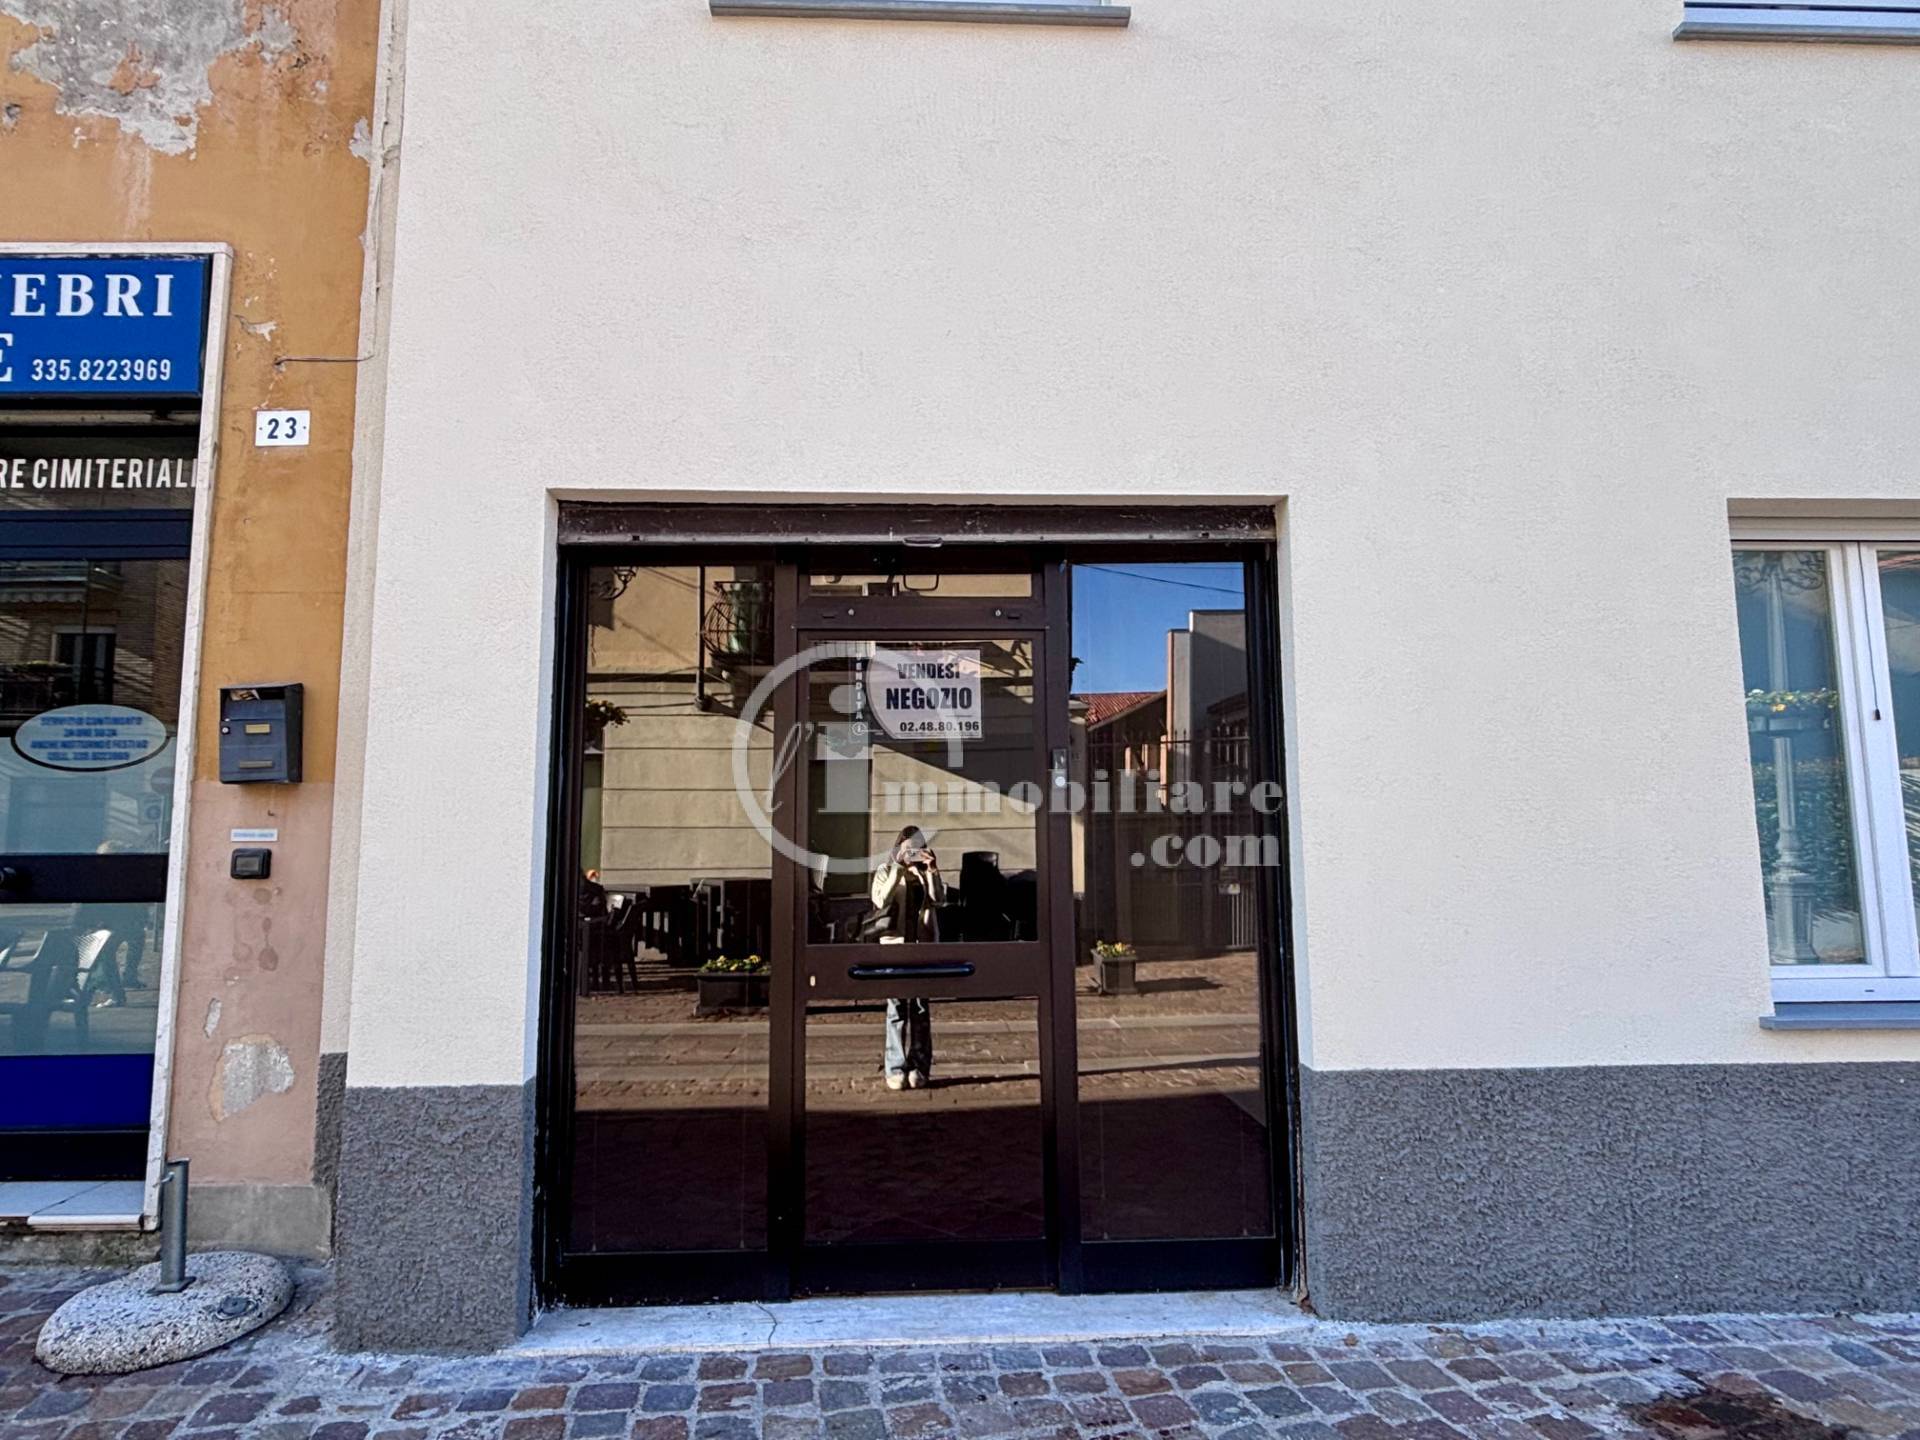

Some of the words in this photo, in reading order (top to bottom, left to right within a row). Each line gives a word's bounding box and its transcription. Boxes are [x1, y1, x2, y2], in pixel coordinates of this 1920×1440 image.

[0, 273, 174, 317] EBRI
[31, 358, 172, 381] 335.8223969
[267, 416, 297, 439] 23
[897, 662, 960, 679] VENDESI
[886, 686, 972, 710] NEGOZIO
[899, 721, 980, 732] 02.48.80.196
